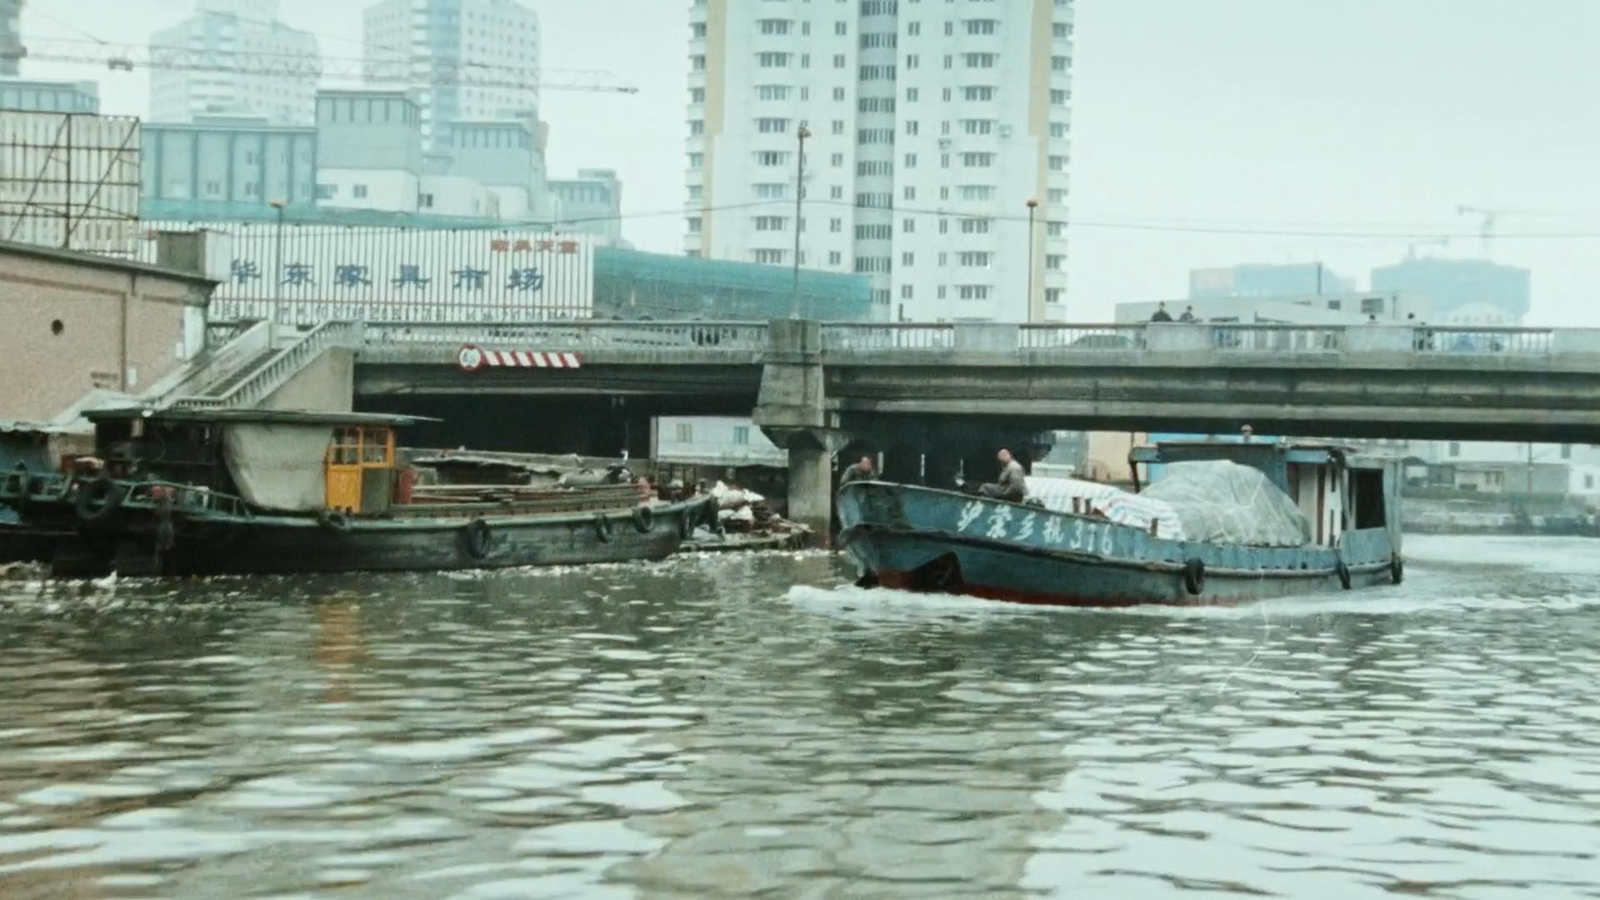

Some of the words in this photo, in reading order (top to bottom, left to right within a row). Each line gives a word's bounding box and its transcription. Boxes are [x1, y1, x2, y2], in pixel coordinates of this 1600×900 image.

[231, 258, 545, 292] 华东家具市场
